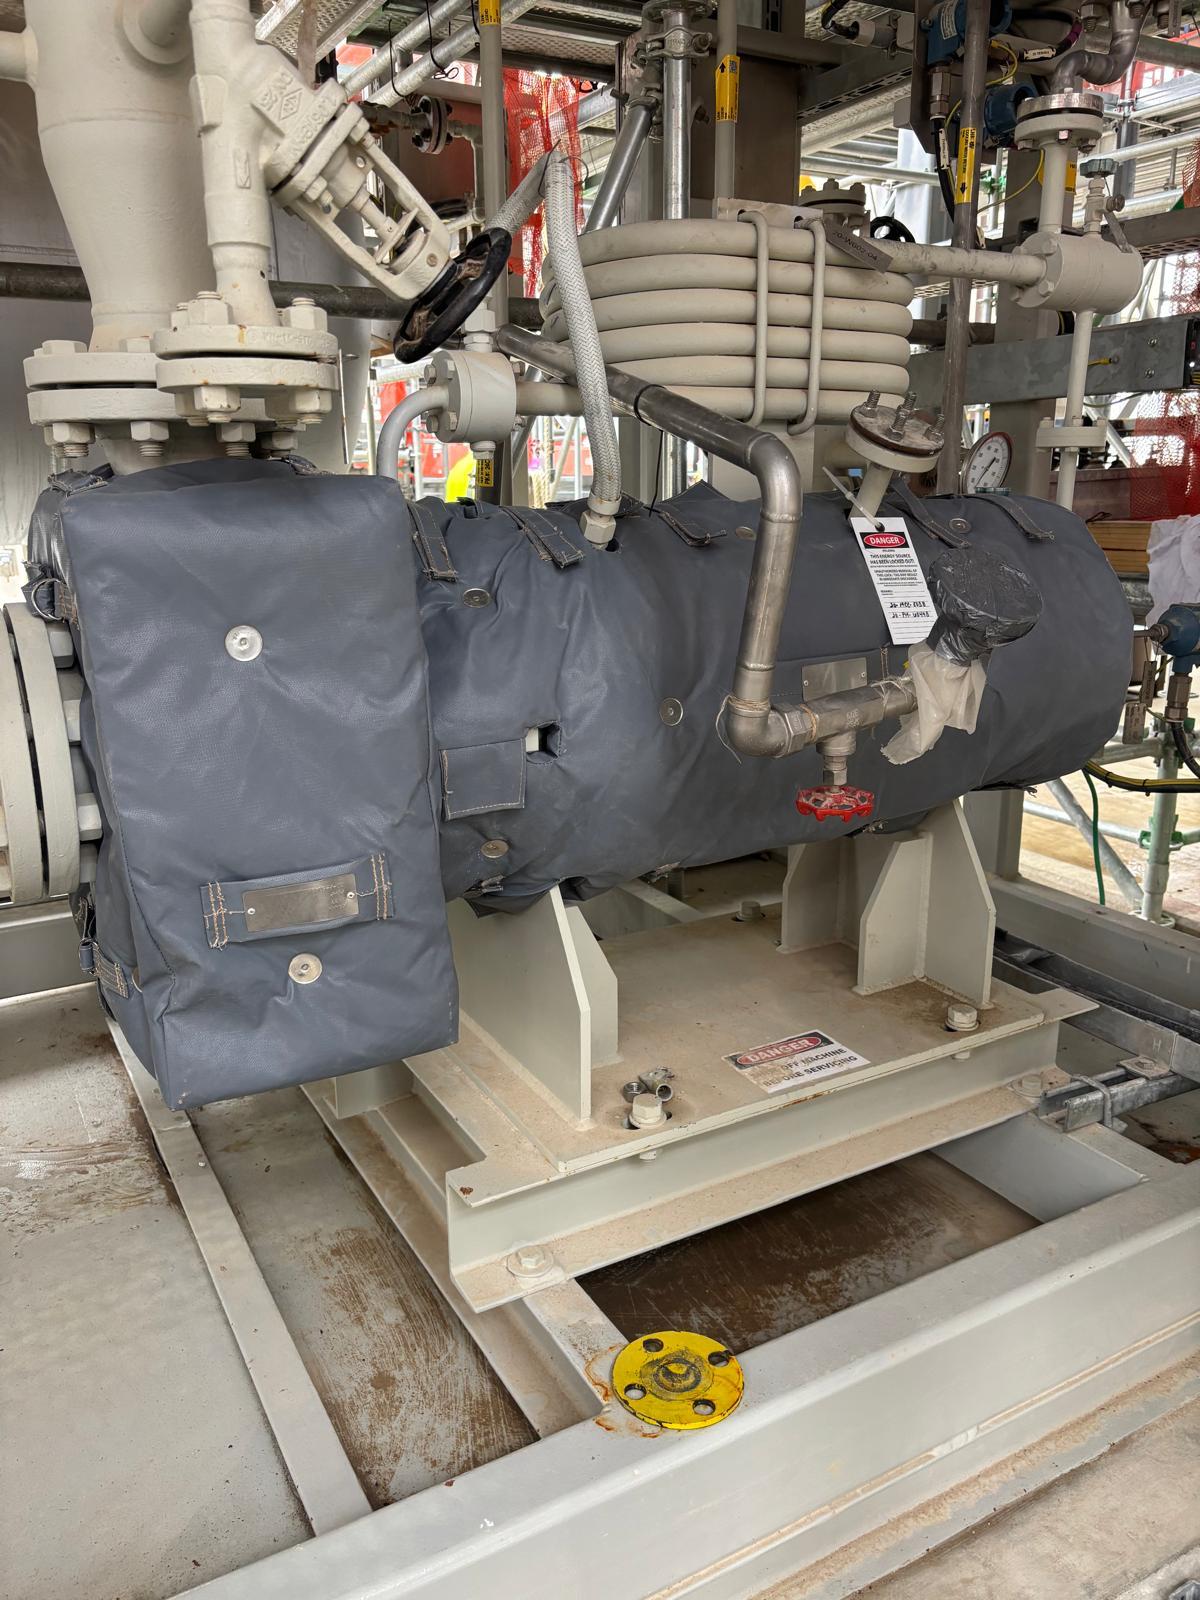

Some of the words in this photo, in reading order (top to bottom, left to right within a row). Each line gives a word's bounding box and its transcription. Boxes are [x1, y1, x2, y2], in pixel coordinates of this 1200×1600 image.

[870, 536, 900, 544] DANGER
[746, 1039, 814, 1062] DANGER
[802, 1048, 847, 1066] MACHINE
[804, 1056, 858, 1074] SERVICING
